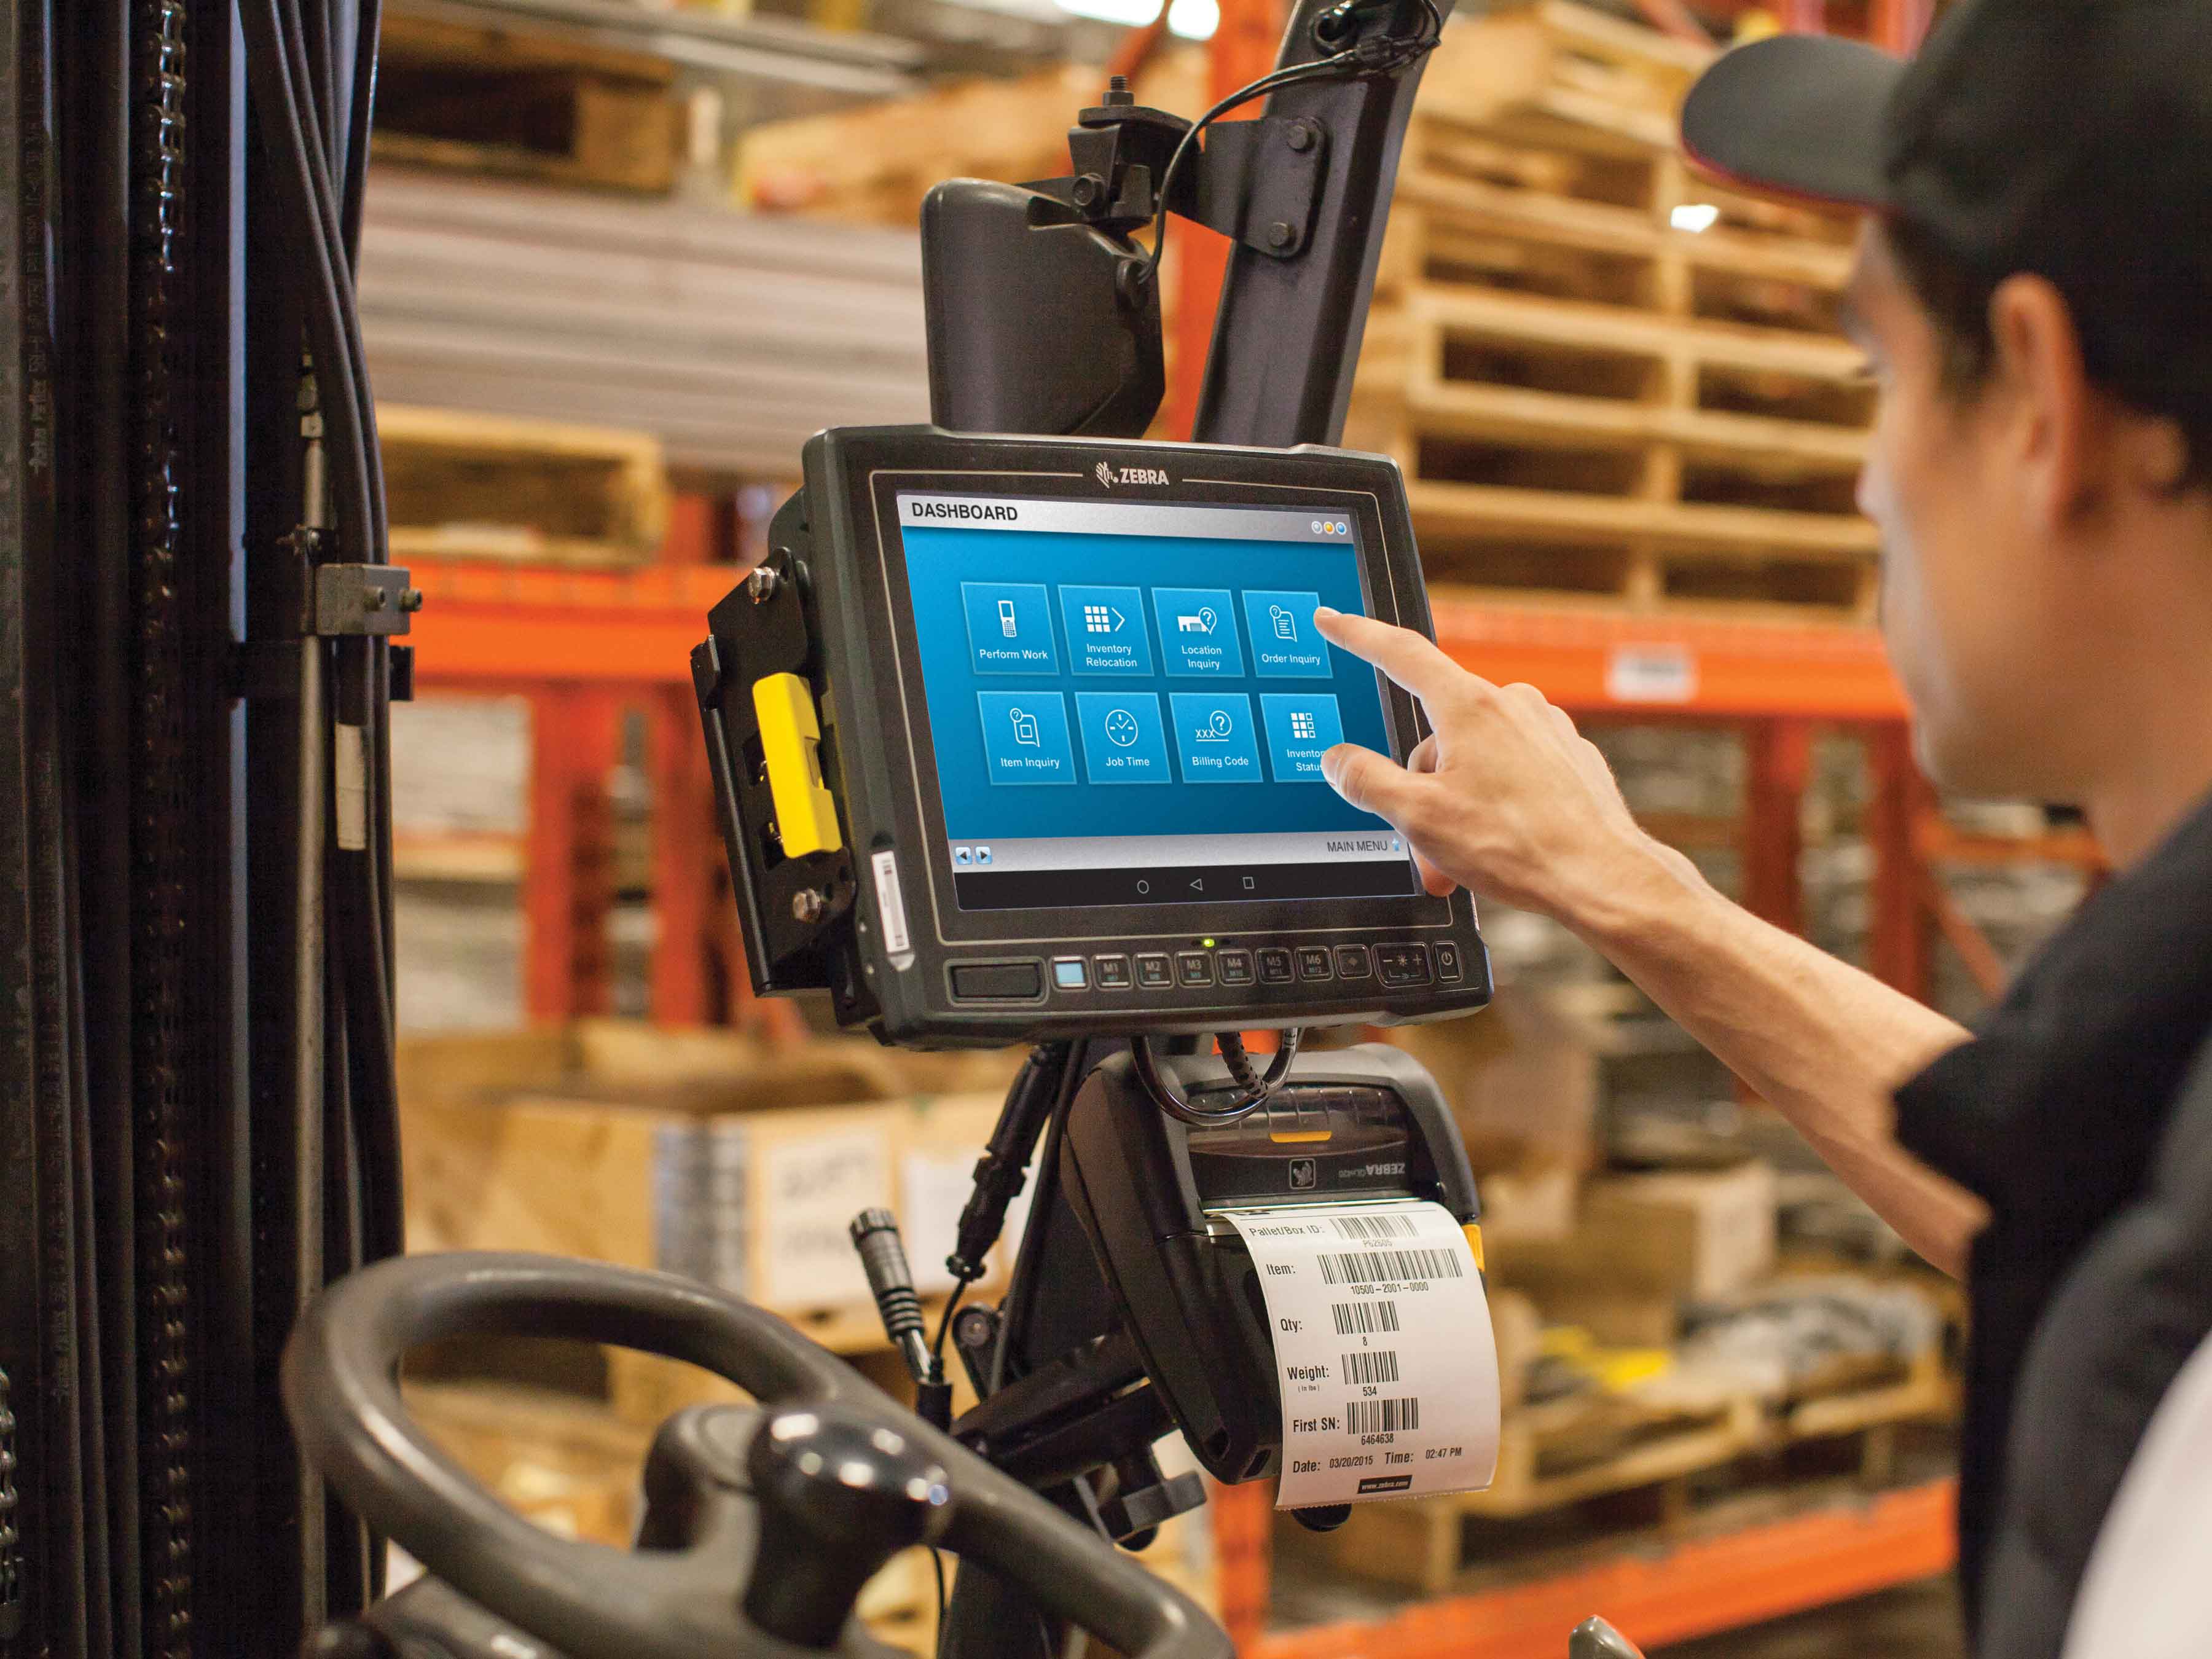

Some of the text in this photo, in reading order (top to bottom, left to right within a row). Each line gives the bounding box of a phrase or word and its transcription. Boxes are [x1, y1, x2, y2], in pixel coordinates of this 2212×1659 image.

[1120, 468, 1169, 485] ZEBRA
[911, 502, 1018, 521] DASHBOARD
[979, 649, 1048, 659] Perform Work
[1086, 643, 1132, 656] Inventory
[1182, 645, 1222, 655] Location
[1086, 657, 1137, 667] Relocation
[1188, 659, 1220, 670] Inquiry
[1261, 653, 1320, 665] Order Inquiry
[1287, 748, 1325, 758] Inventor
[1000, 757, 1059, 769] Item Inquiry
[1106, 756, 1150, 767] Job Time
[1192, 756, 1249, 767] Billing Code
[1327, 840, 1388, 852] MAIN MENU
[1228, 958, 1242, 969] M4
[1266, 956, 1282, 966] M5
[1306, 954, 1321, 965] M6
[1145, 961, 1161, 972] M2
[1186, 960, 1201, 971] M3
[1366, 1163, 1405, 1175] ZEBRA
[1249, 1226, 1304, 1237] Pallet/Box
[1266, 1264, 1296, 1276] Item:
[1280, 1318, 1303, 1333] Qty:
[1362, 1336, 1368, 1346] 8
[1287, 1365, 1330, 1382] Weight:
[1363, 1386, 1377, 1397] 534
[1293, 1416, 1340, 1433] First SN:
[1361, 1433, 1394, 1445] 6464638
[1293, 1447, 1462, 1473] Date: 03/20/2015 Time: 02:47 PM
